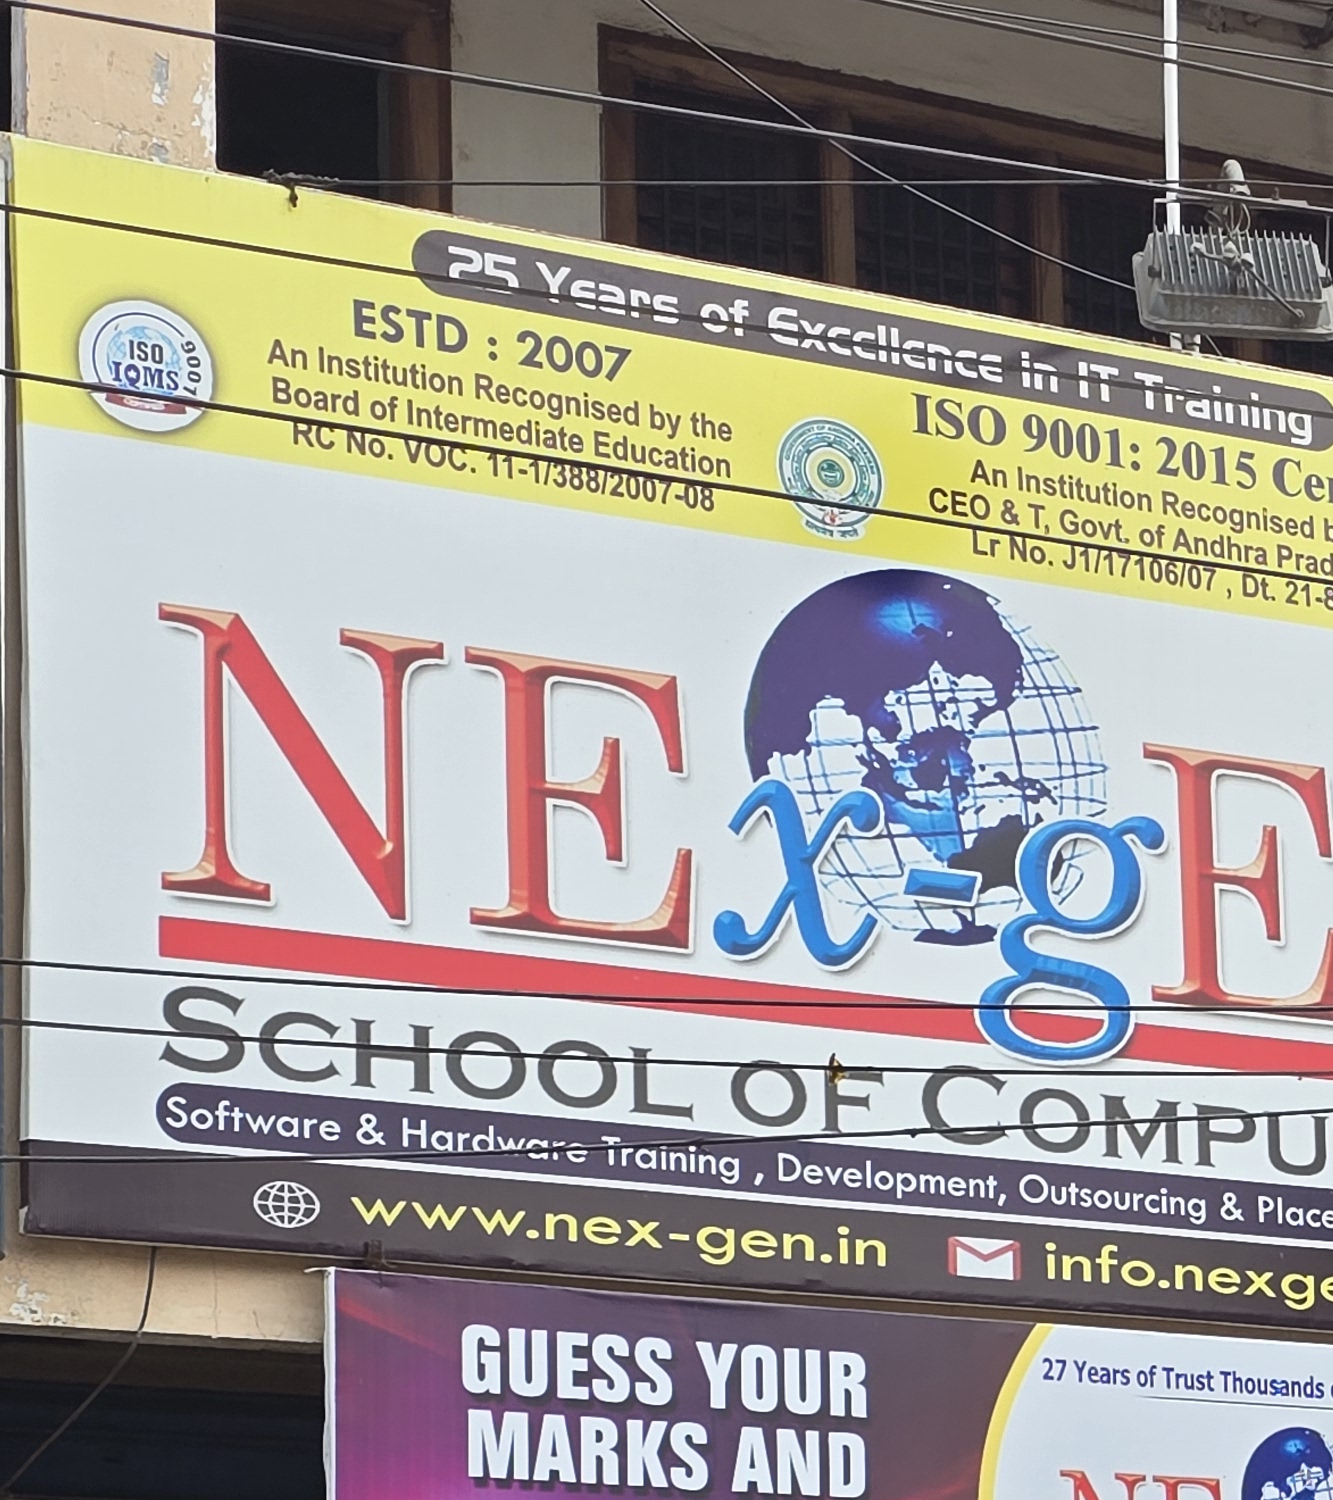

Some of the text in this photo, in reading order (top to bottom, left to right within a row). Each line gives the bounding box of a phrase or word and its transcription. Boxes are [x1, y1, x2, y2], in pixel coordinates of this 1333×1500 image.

[112, 361, 179, 391] IQMS
[129, 340, 163, 364] ISO
[447, 247, 1313, 445] 25 Years of Excellence in IT Training
[271, 377, 732, 479] Board of Intermediate Education
[292, 422, 714, 512] RC No. VOC. 11-1/388/2007-08
[912, 392, 1005, 446] ISO
[1023, 414, 1140, 471] 9001:
[1157, 436, 1257, 490] 2015
[929, 488, 990, 521] CEO
[1001, 499, 1020, 526] &
[1026, 504, 1050, 535] T,
[1059, 510, 1131, 544] Govt.
[1139, 522, 1165, 551] of
[1173, 528, 1267, 566] Andhra
[159, 986, 694, 1122] SCHOOL
[731, 1060, 884, 1134] OF
[351, 1196, 887, 1267] www.nex-gen.in
[462, 1324, 868, 1418] GUESS YOUR
[1043, 1358, 1067, 1383] 27
[1074, 1360, 1131, 1387] Years
[1136, 1365, 1157, 1388] of
[1163, 1367, 1215, 1392] Trust
[1221, 1370, 1325, 1400] Thousands
[467, 1409, 867, 1498] MARKS AND
